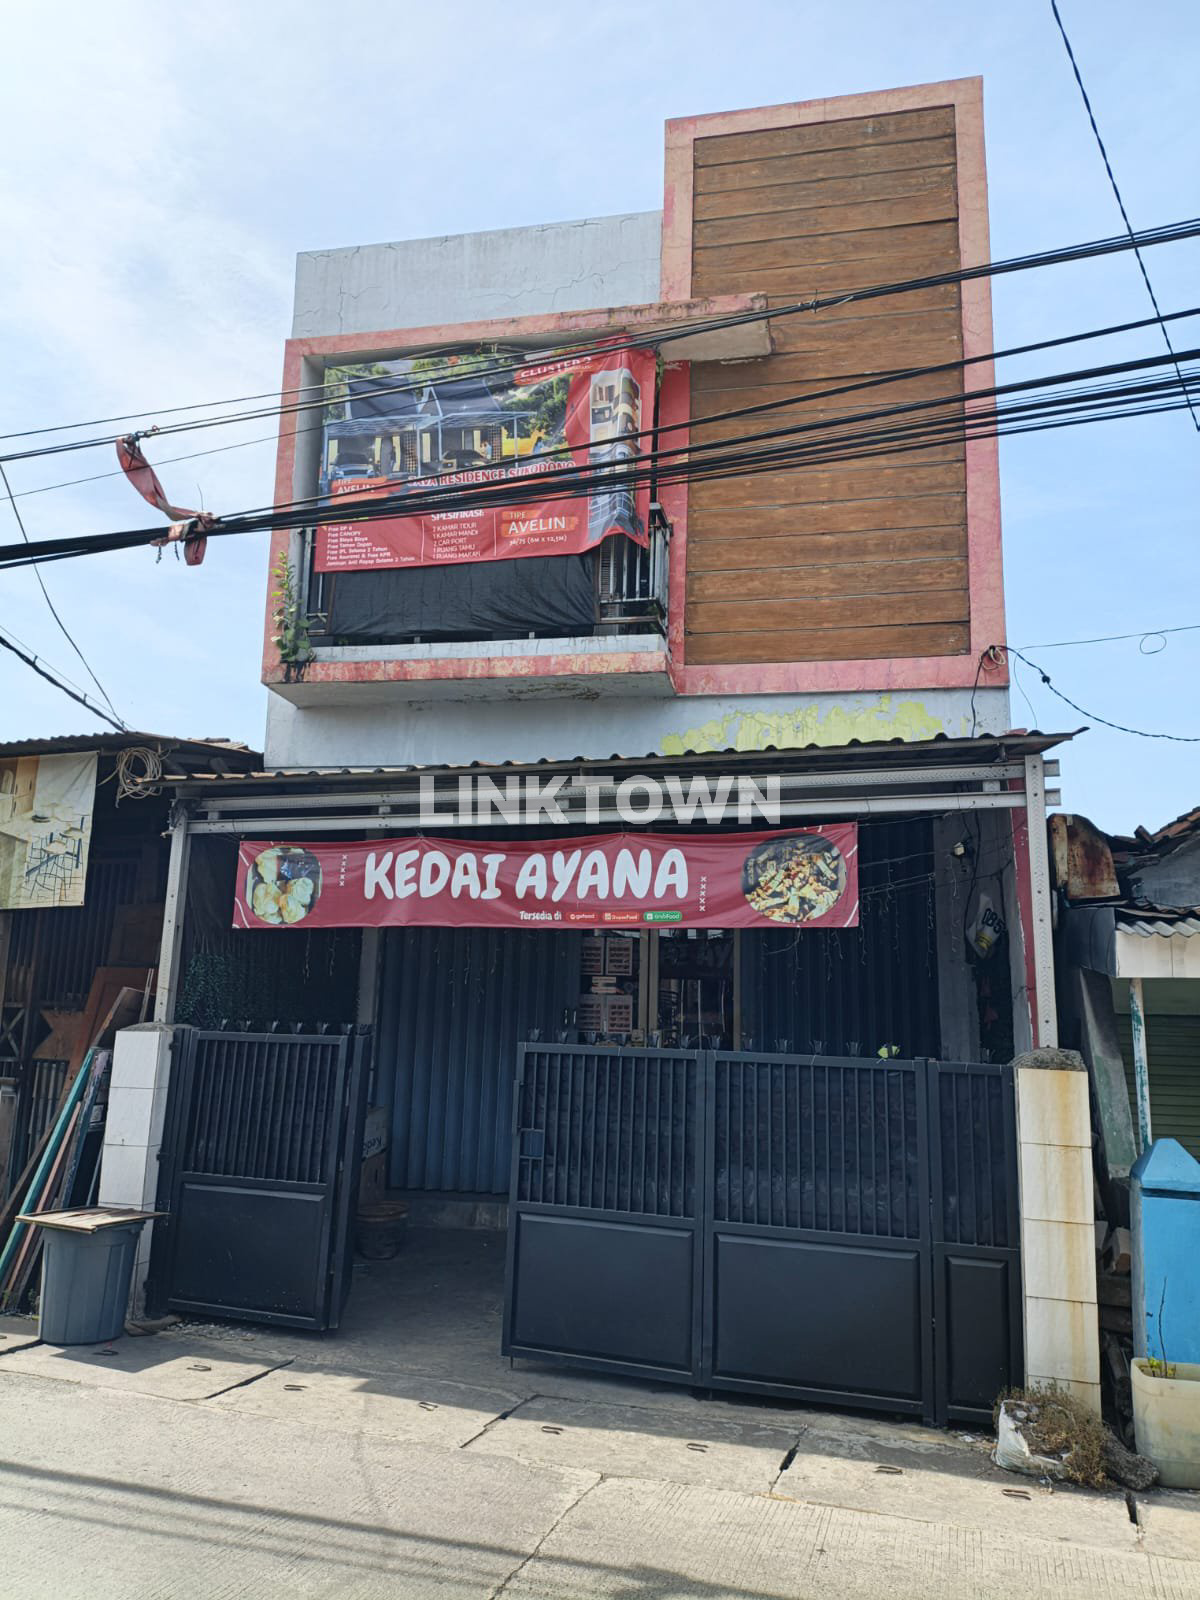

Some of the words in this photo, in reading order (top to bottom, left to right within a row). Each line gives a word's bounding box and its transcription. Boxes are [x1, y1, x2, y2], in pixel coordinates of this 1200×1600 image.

[439, 468, 505, 486] RESIDENCE
[509, 516, 565, 534] AVELIN
[364, 848, 506, 901] KEDAI
[516, 848, 688, 902] AYANA
[520, 911, 552, 920] Tersedia
[554, 911, 562, 920] di
